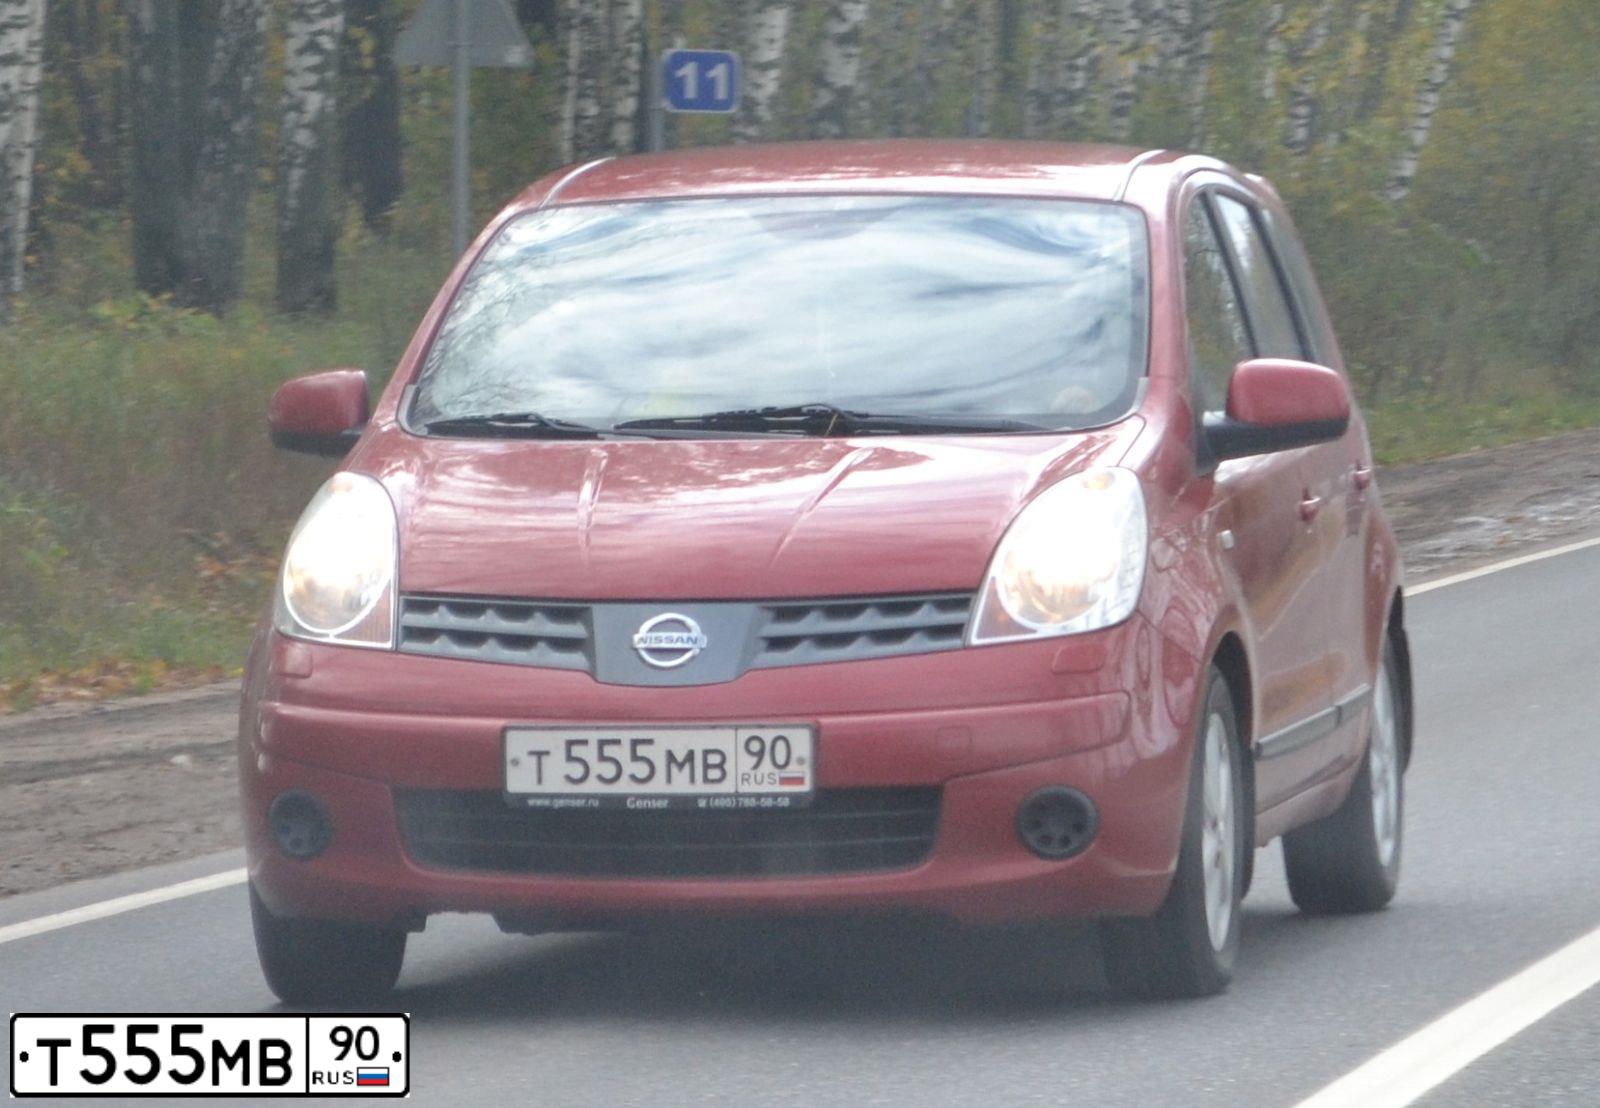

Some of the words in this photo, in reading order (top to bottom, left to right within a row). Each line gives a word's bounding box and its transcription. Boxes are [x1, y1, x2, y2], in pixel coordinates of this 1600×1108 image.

[674, 61, 729, 100] 11
[637, 635, 698, 645] NISSAN
[743, 735, 792, 770] 90
[741, 773, 777, 786] RUS
[626, 797, 668, 808] Genser
